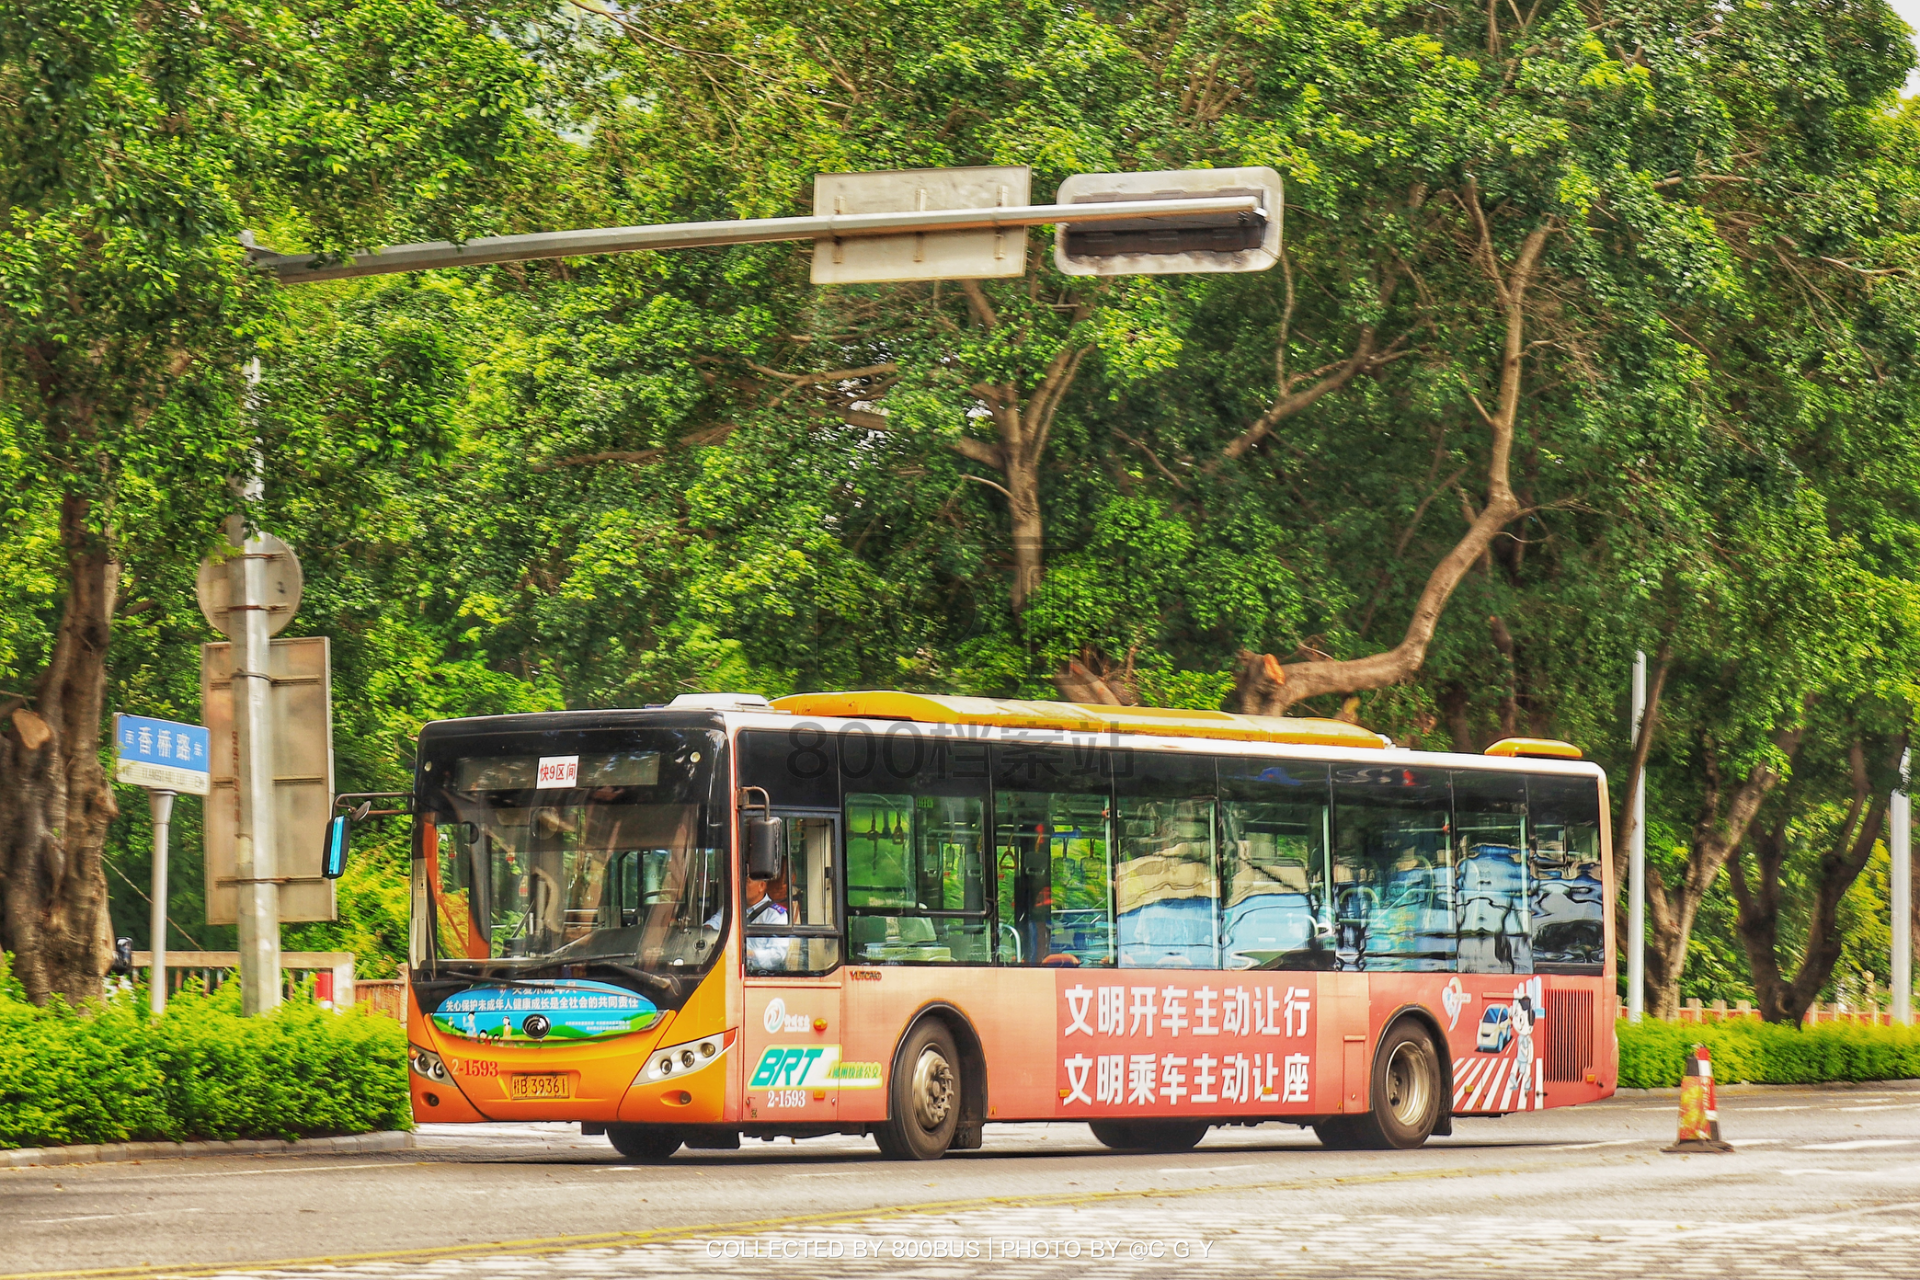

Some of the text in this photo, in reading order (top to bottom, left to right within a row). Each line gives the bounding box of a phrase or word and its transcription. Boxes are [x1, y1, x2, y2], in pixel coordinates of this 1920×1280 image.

[540, 762, 576, 782] 快9区间
[445, 996, 639, 1012] 关心保护未成年人健康成长是全社会的共同责任
[1064, 984, 1311, 1038] 文明开车主动让行
[451, 1058, 499, 1078] 2-1593
[750, 1048, 825, 1086] BRT
[1063, 1052, 1310, 1107] 文明乘车主动让座
[767, 1089, 806, 1108] 2-1593
